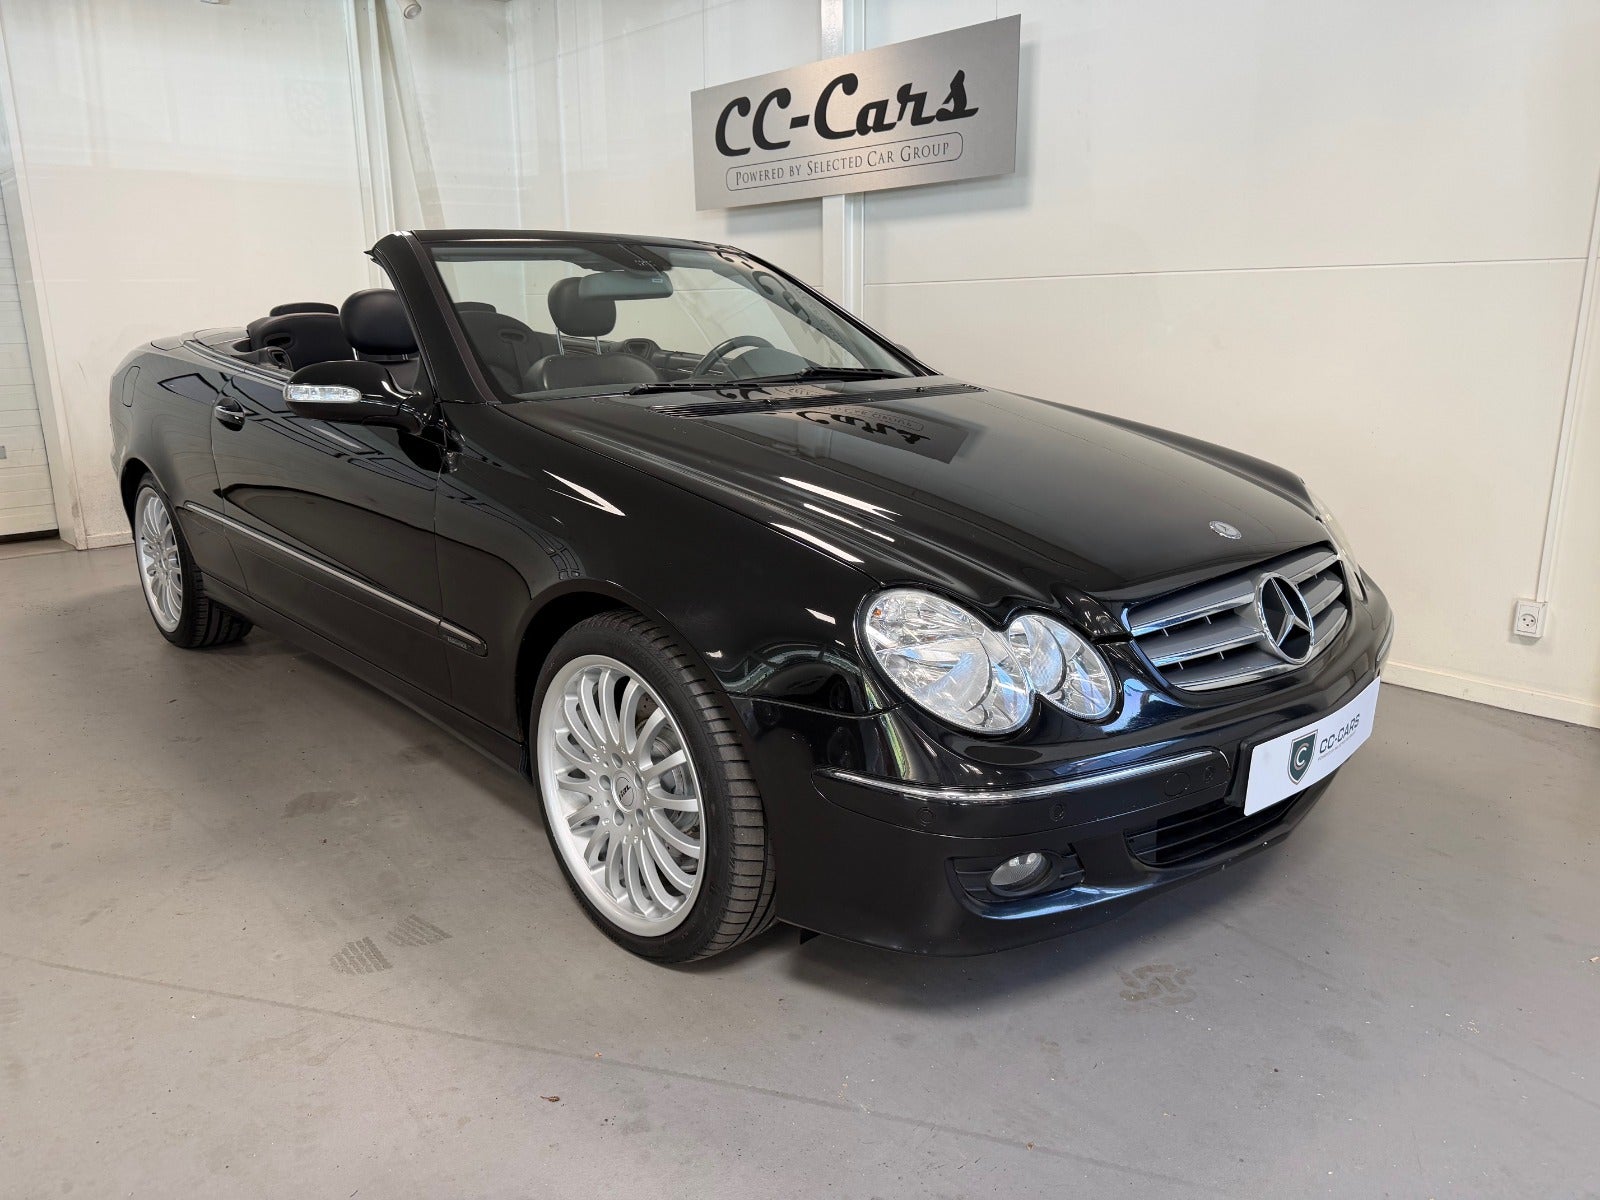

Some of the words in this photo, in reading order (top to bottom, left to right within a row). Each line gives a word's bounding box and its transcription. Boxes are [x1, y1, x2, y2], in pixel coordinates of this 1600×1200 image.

[715, 69, 979, 157] CC-Cars
[735, 167, 785, 186] POWERED
[807, 155, 863, 176] SELECTED
[867, 150, 895, 167] CAR
[900, 142, 949, 162] GROUP
[1319, 713, 1360, 754] CC-CARS
